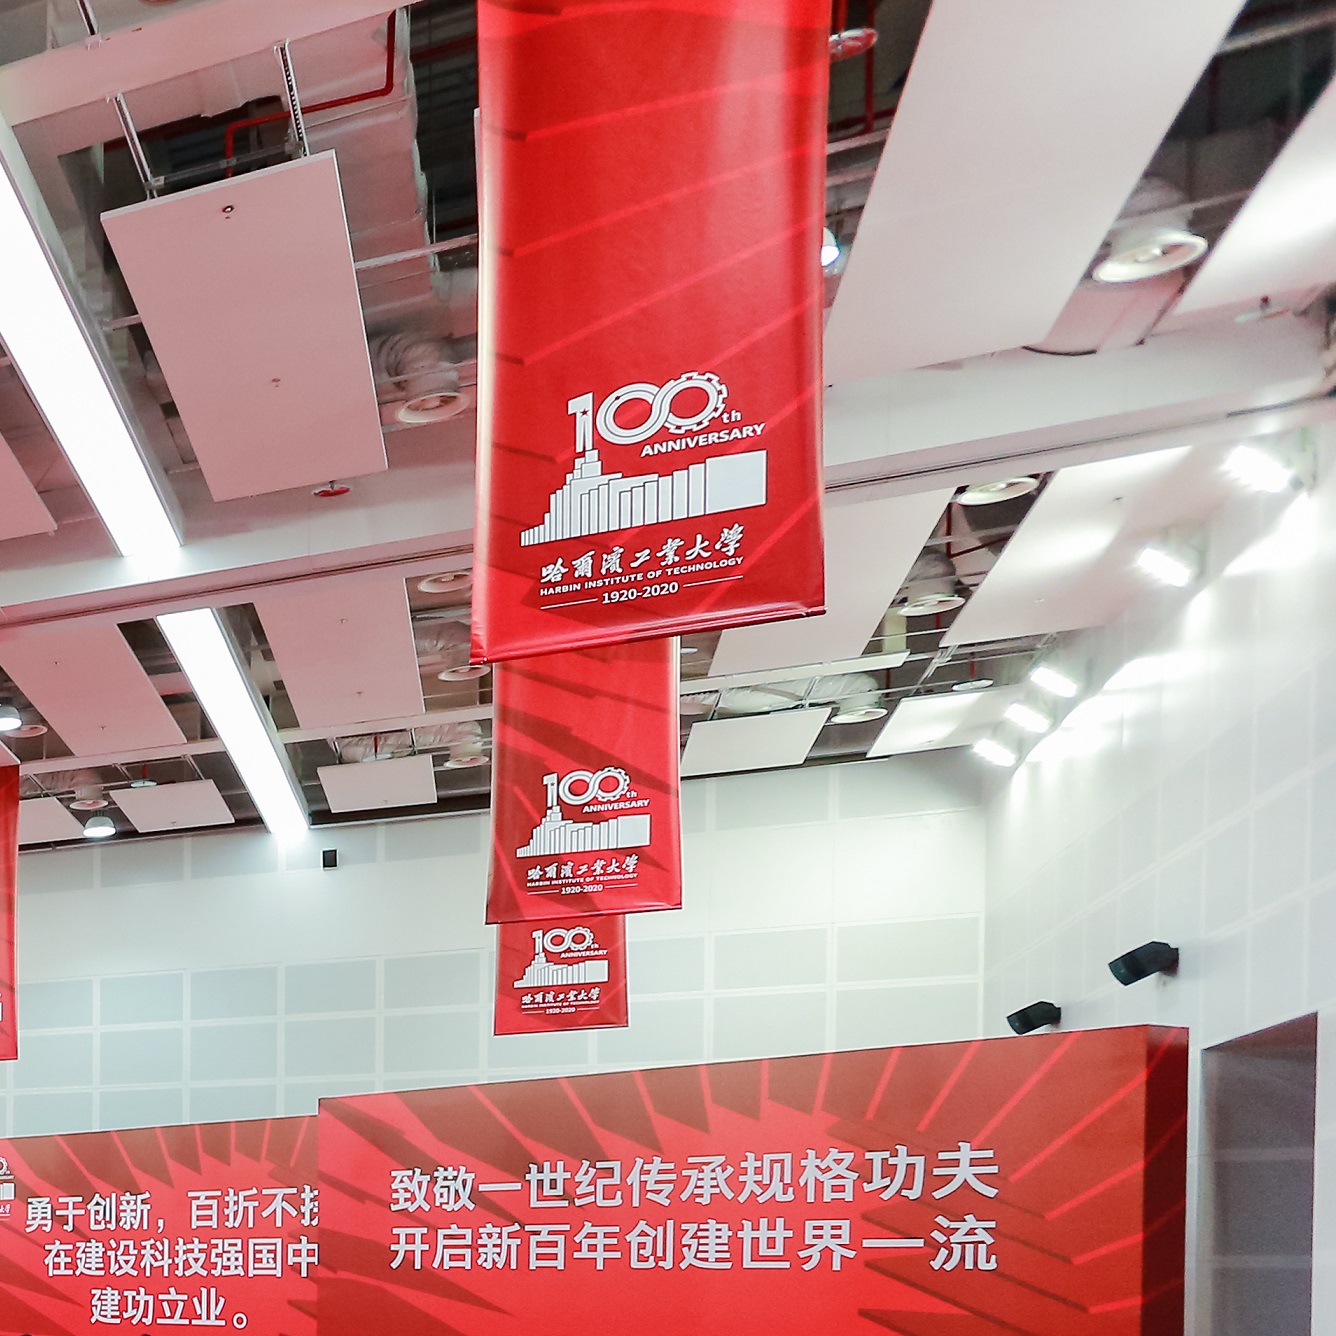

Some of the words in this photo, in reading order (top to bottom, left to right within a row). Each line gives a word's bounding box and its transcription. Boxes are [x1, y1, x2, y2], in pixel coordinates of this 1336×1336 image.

[640, 423, 766, 457] ANNIVERSARY
[540, 582, 581, 596] HARBIN
[585, 573, 643, 589] INSTITUTE
[647, 569, 663, 580] OF
[666, 556, 744, 576] TECHNOLOGY
[602, 582, 678, 604] 1920-2020
[582, 799, 649, 813] ANNIVERSARY
[561, 884, 603, 894] 1920-2020
[390, 1142, 999, 1214] 致敬一世纪传承规格功夫
[44, 1235, 319, 1277] 在建设科技强国中
[390, 1214, 999, 1272] 开启新百年创建世界一流
[90, 1287, 248, 1329] 建功立业。
